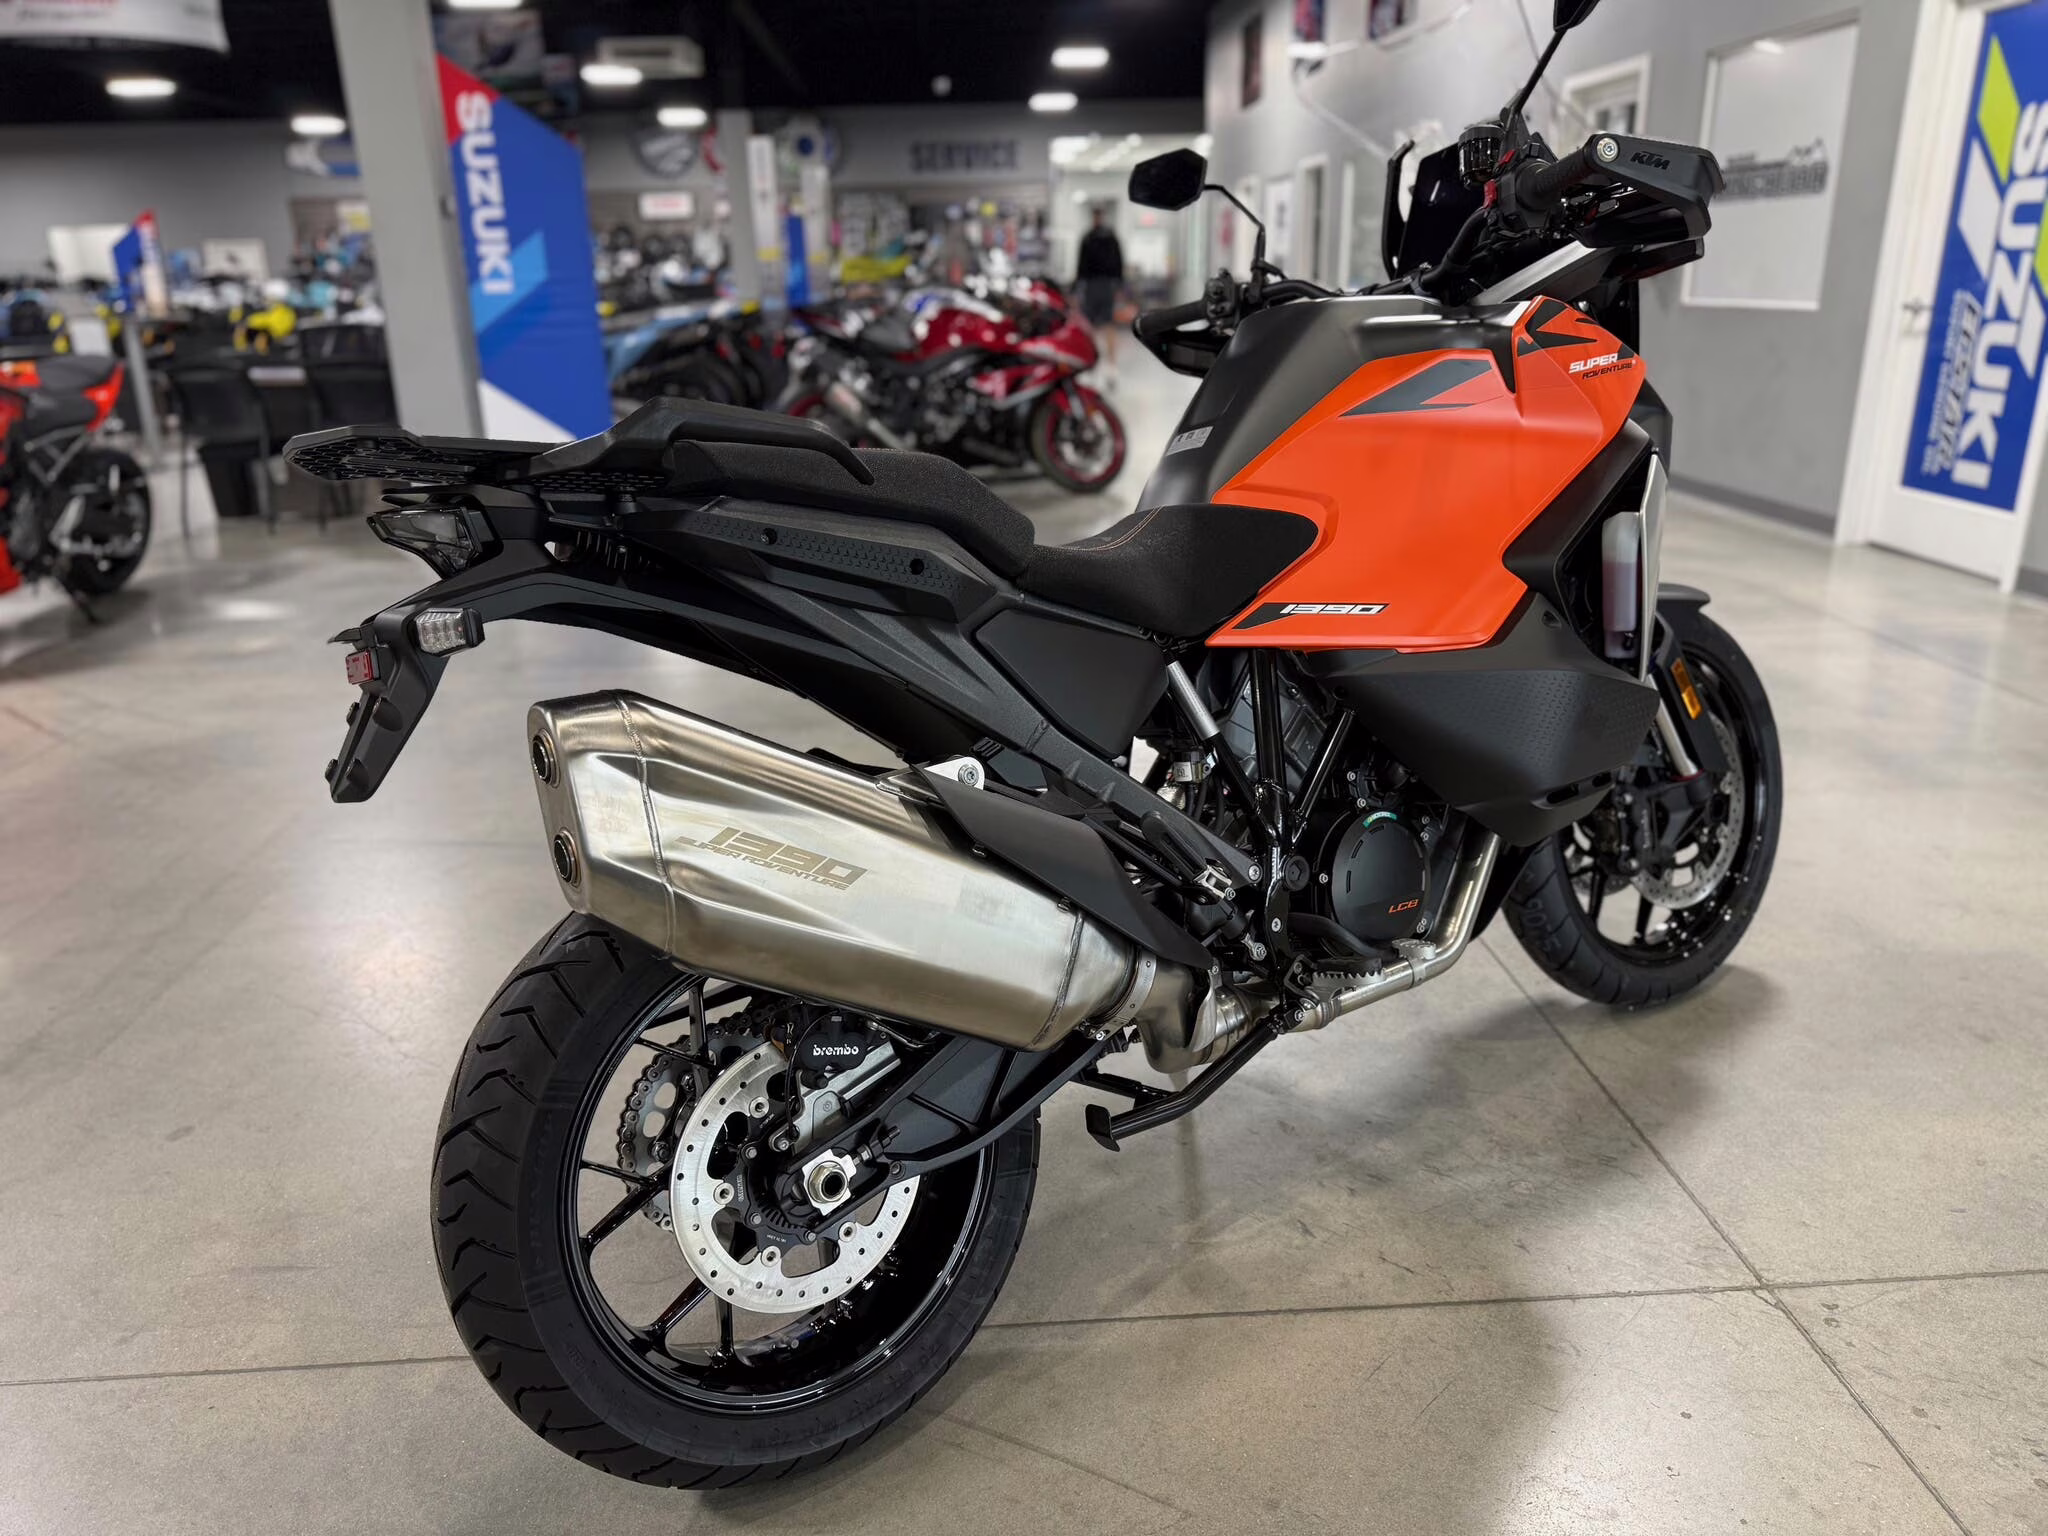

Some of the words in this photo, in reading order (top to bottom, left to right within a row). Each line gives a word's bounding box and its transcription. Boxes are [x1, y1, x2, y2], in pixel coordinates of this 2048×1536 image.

[1630, 151, 1670, 170] KTM
[455, 90, 515, 294] SUZUKI
[1951, 100, 2048, 489] SUZUKI
[1568, 352, 1618, 374] SUPER
[1582, 362, 1632, 379] ADVENTURE
[1280, 603, 1386, 615] 1390
[674, 835, 742, 860] SUPER
[741, 855, 851, 891] ADVENTURE
[709, 826, 868, 886] 1390
[1388, 899, 1419, 914] LC8
[812, 1043, 859, 1056] brembo
